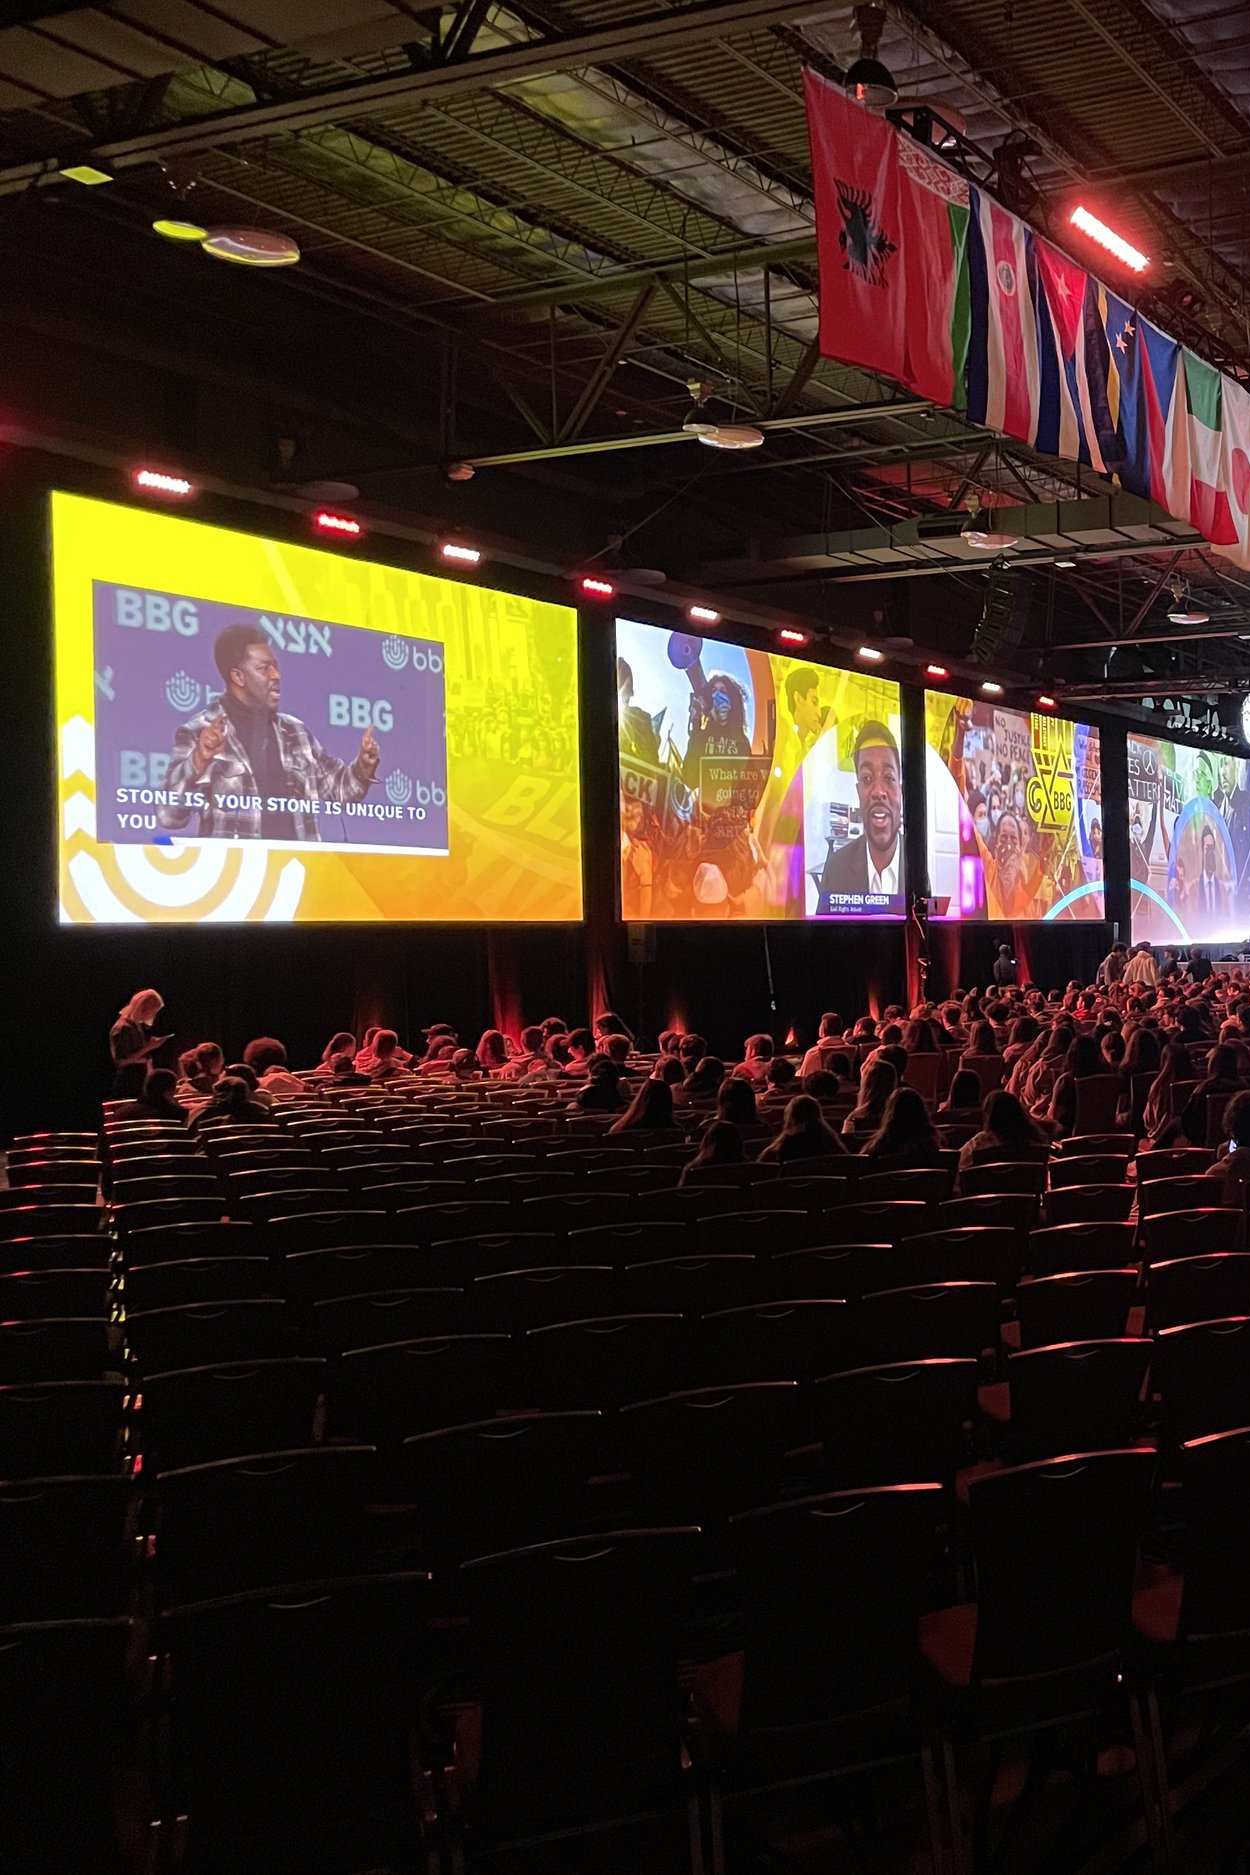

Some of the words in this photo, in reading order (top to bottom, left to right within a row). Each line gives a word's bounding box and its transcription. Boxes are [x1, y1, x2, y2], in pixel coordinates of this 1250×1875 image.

[115, 589, 199, 637] BBG
[329, 694, 394, 732] BBG
[709, 768, 737, 781] What
[740, 771, 759, 781] are
[116, 788, 179, 806] STONE
[184, 792, 209, 811] IS,
[214, 794, 263, 810] YOUR
[267, 797, 320, 814] STONE
[324, 801, 342, 815] IS
[346, 804, 403, 820] UNIQUE
[407, 807, 426, 820] TO
[1054, 791, 1072, 811] BBG
[117, 813, 157, 830] YOU
[829, 893, 864, 905] STEPHEN
[865, 894, 890, 905] GREEN
